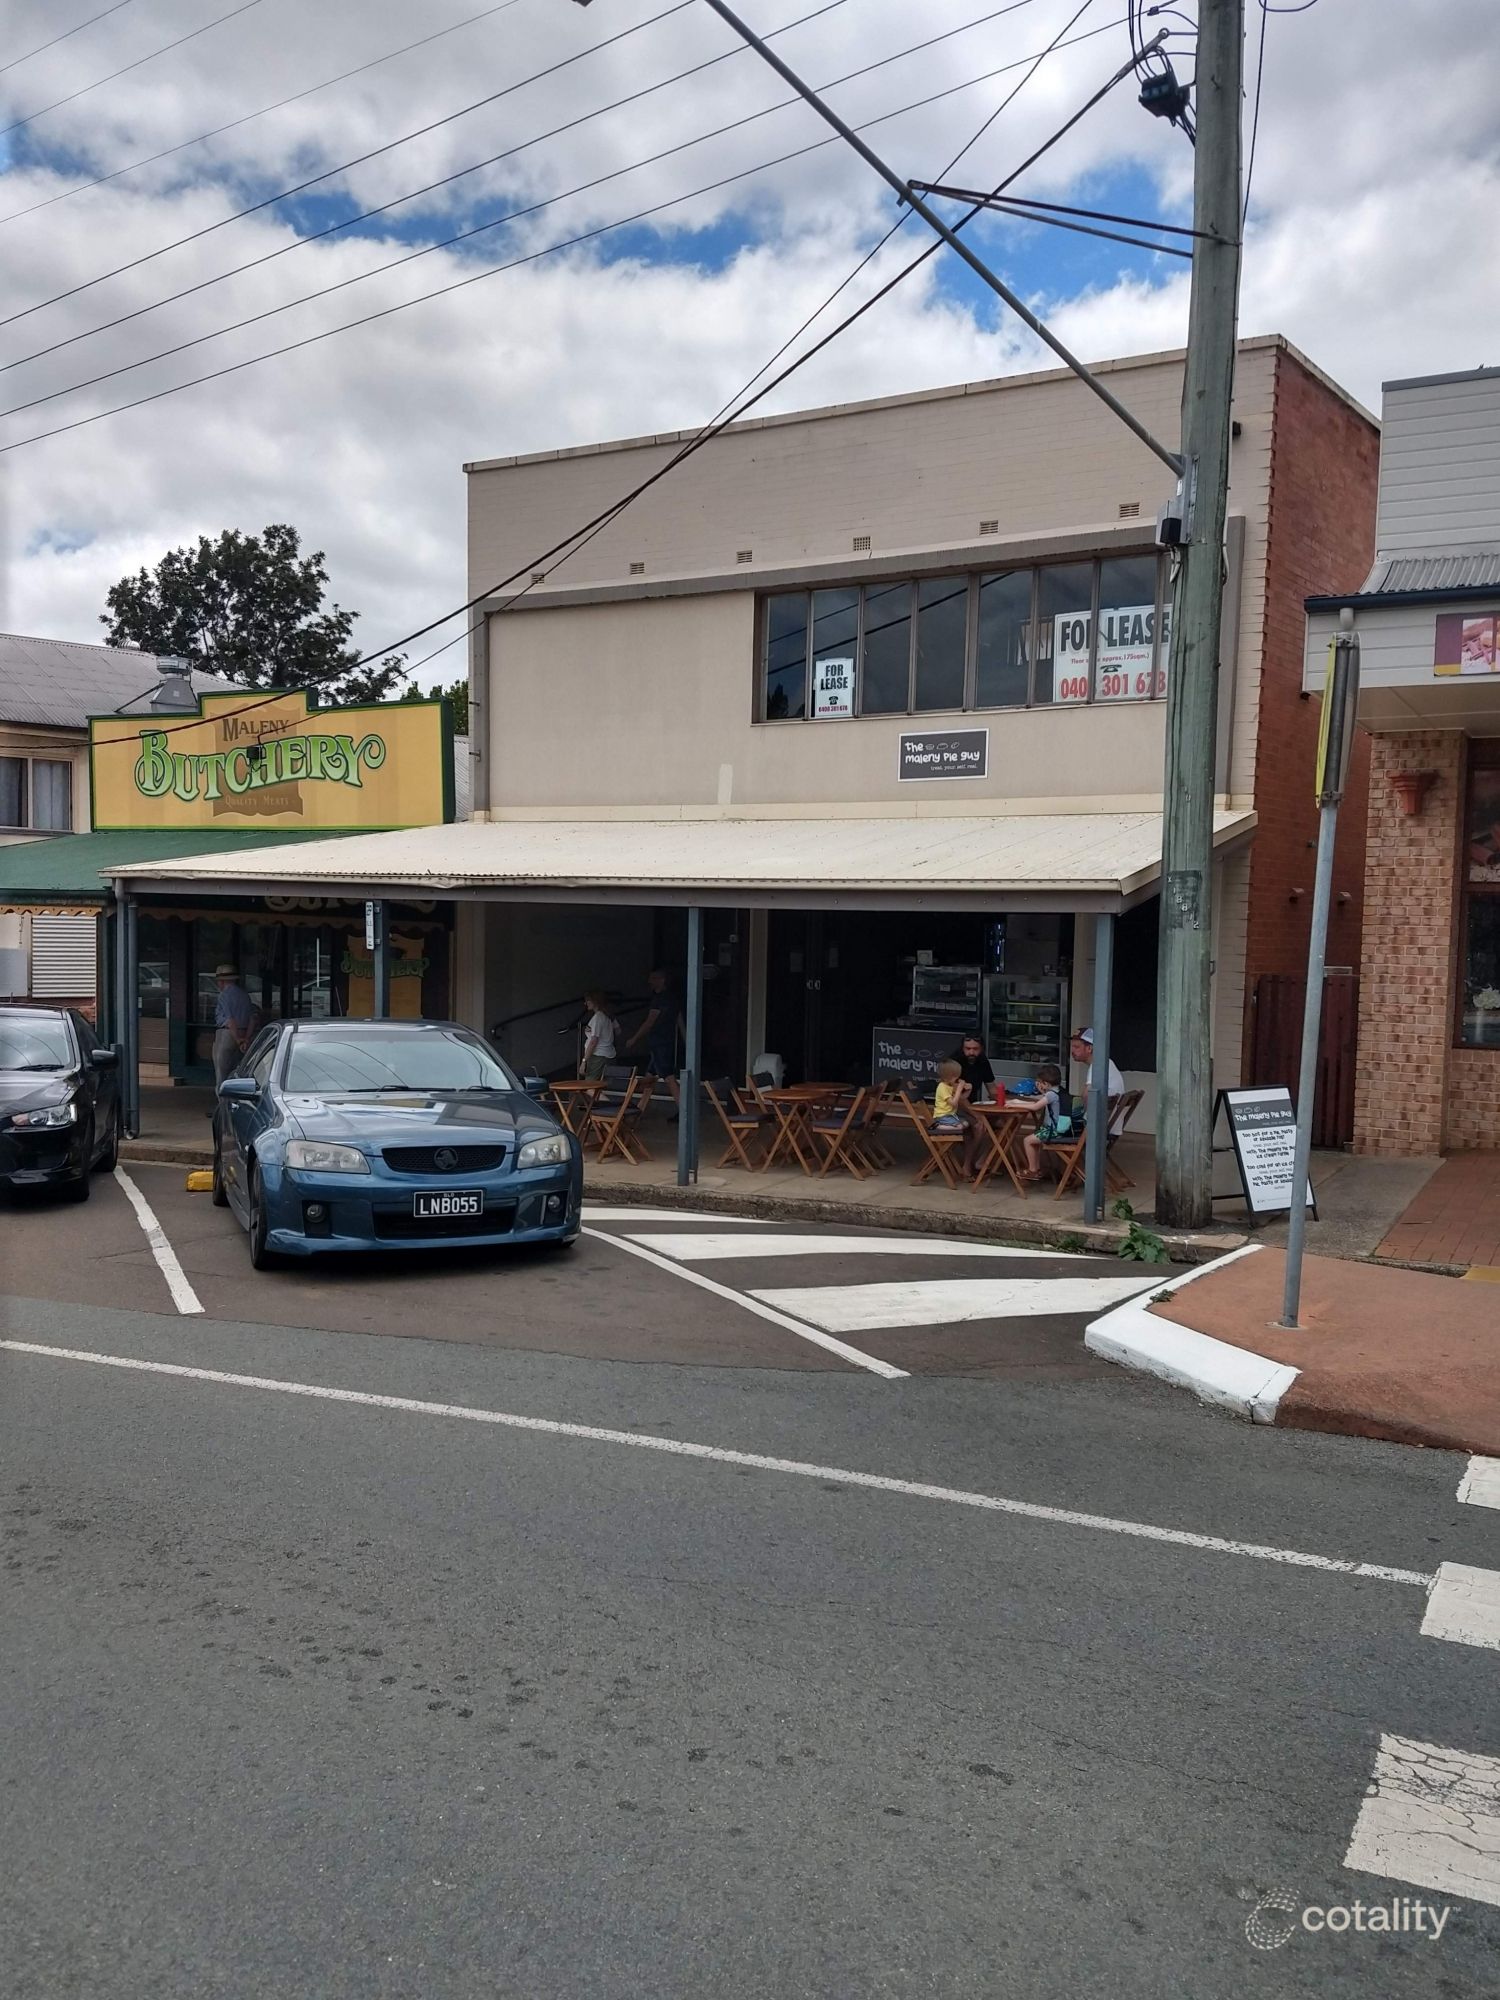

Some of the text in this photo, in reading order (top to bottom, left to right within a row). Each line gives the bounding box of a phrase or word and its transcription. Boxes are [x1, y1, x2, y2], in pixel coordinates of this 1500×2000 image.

[1107, 612, 1170, 647] LEASE
[825, 664, 844, 677] FOR
[821, 677, 849, 690] LEASE
[1060, 676, 1096, 699] 040
[1102, 674, 1129, 696] 301
[222, 717, 289, 742] MALENY
[135, 729, 387, 801] BUTCHERY
[420, 1196, 478, 1215] LNB055
